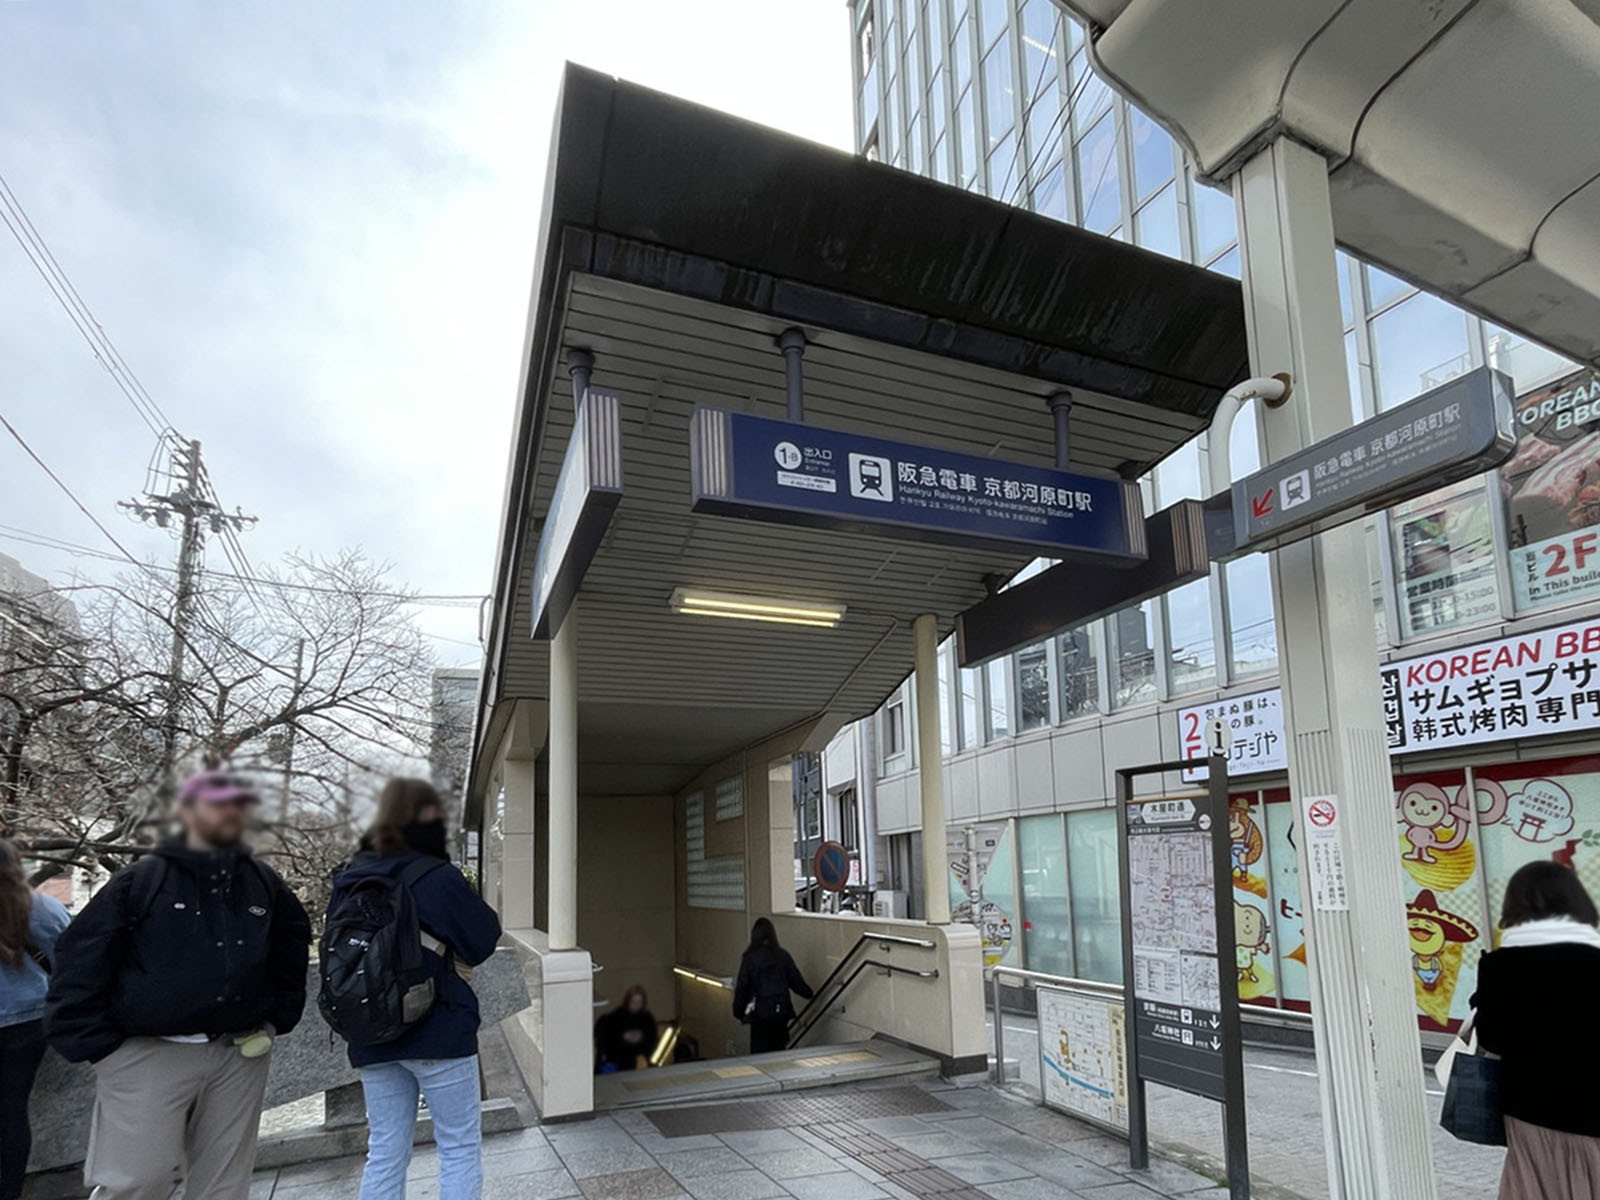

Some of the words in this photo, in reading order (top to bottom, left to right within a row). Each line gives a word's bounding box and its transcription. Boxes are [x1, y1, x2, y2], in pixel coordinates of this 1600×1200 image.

[1516, 380, 1600, 424] OREAN
[803, 447, 832, 460] 出入口
[1314, 445, 1366, 480] 阪急電車
[1369, 402, 1460, 457] 京都河原町駅
[897, 461, 978, 492] 阪急電車
[983, 477, 1093, 512] 京都河原町駅
[899, 484, 932, 498] Hankyu
[934, 489, 966, 504] Railway
[1047, 507, 1074, 518] Station
[1542, 532, 1598, 578] 2F
[1543, 580, 1570, 591] This
[1406, 638, 1542, 688] KOREAN
